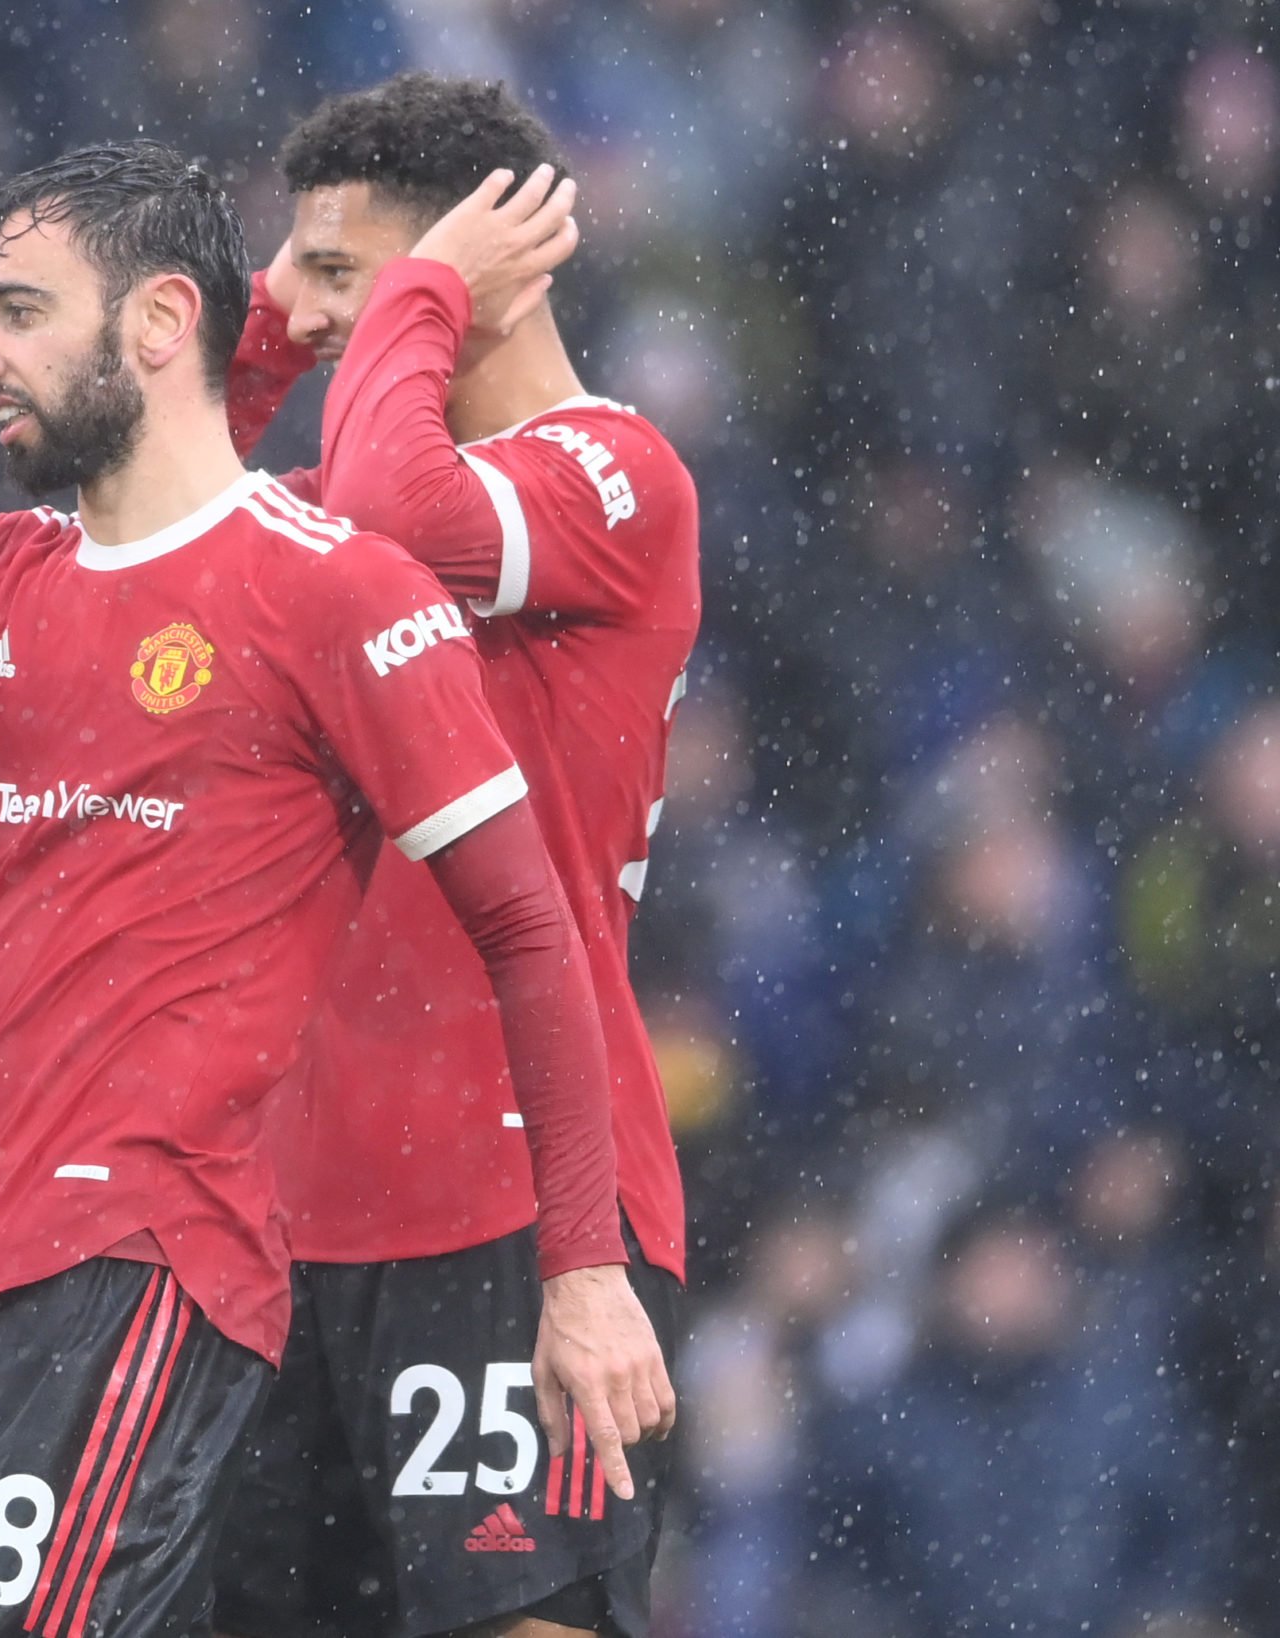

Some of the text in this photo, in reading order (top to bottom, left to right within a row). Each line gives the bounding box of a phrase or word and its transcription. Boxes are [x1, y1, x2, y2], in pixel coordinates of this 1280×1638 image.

[144, 629, 207, 662] MANCHESTER
[140, 690, 186, 708] UNITED
[390, 1362, 539, 1496] 25
[464, 1534, 536, 1552] adidas
